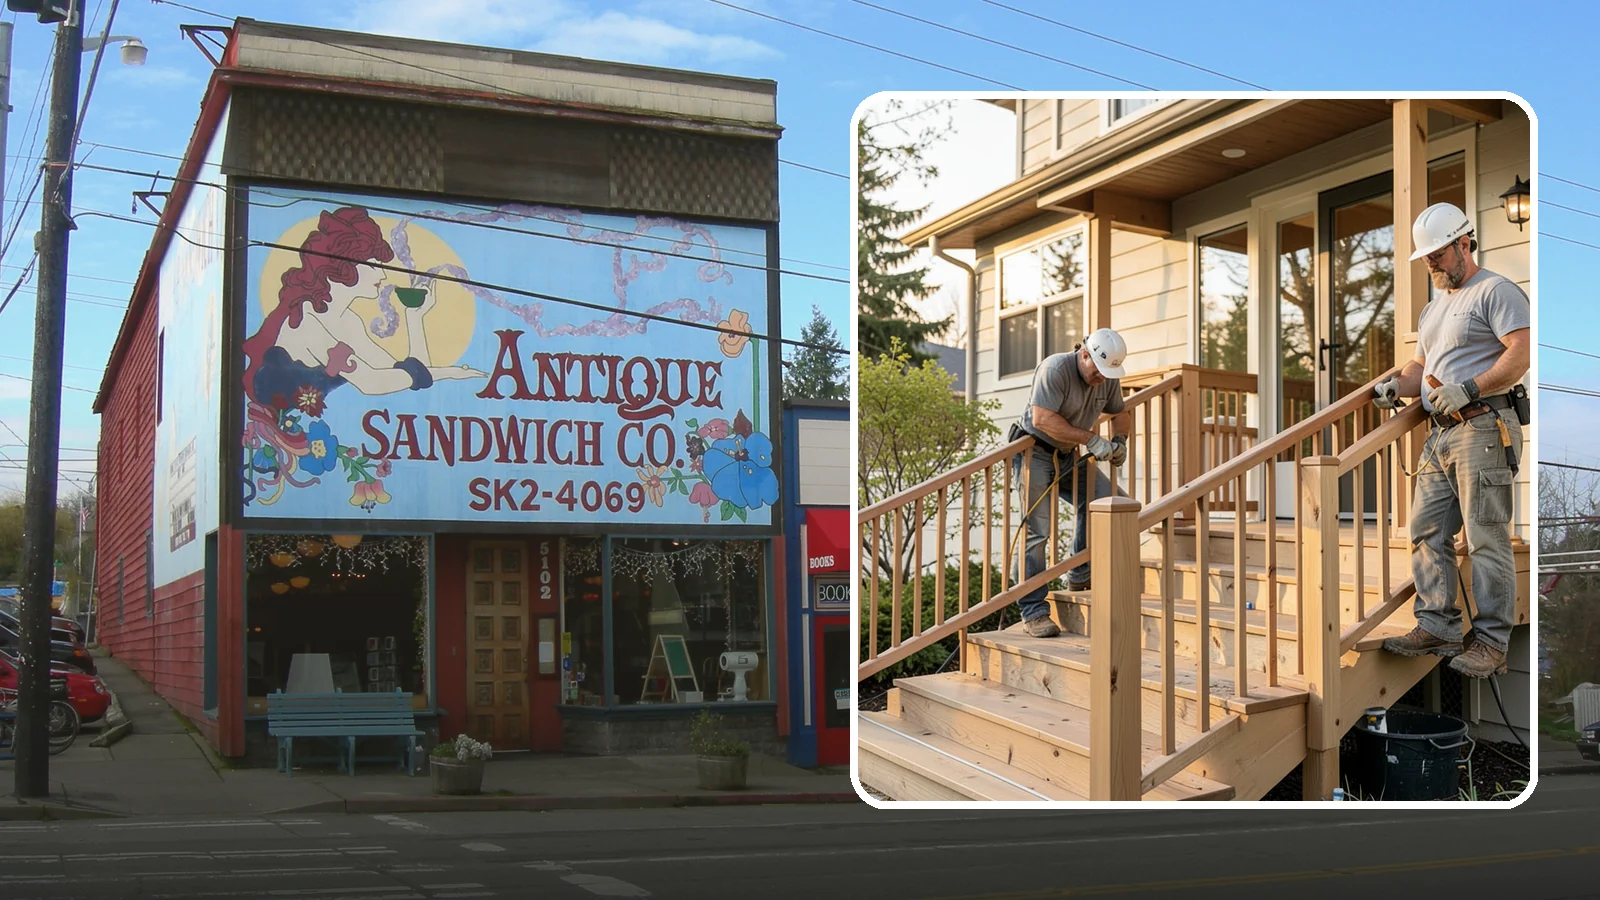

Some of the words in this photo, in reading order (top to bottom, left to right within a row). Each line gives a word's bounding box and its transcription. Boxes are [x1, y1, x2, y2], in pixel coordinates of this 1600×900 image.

[476, 329, 723, 421] ANTIQUE
[361, 408, 604, 467] SANDWICH
[616, 421, 685, 468] CO.
[468, 476, 645, 513] SK2-4069
[539, 541, 552, 600] 5102
[809, 555, 835, 569] BOOKS
